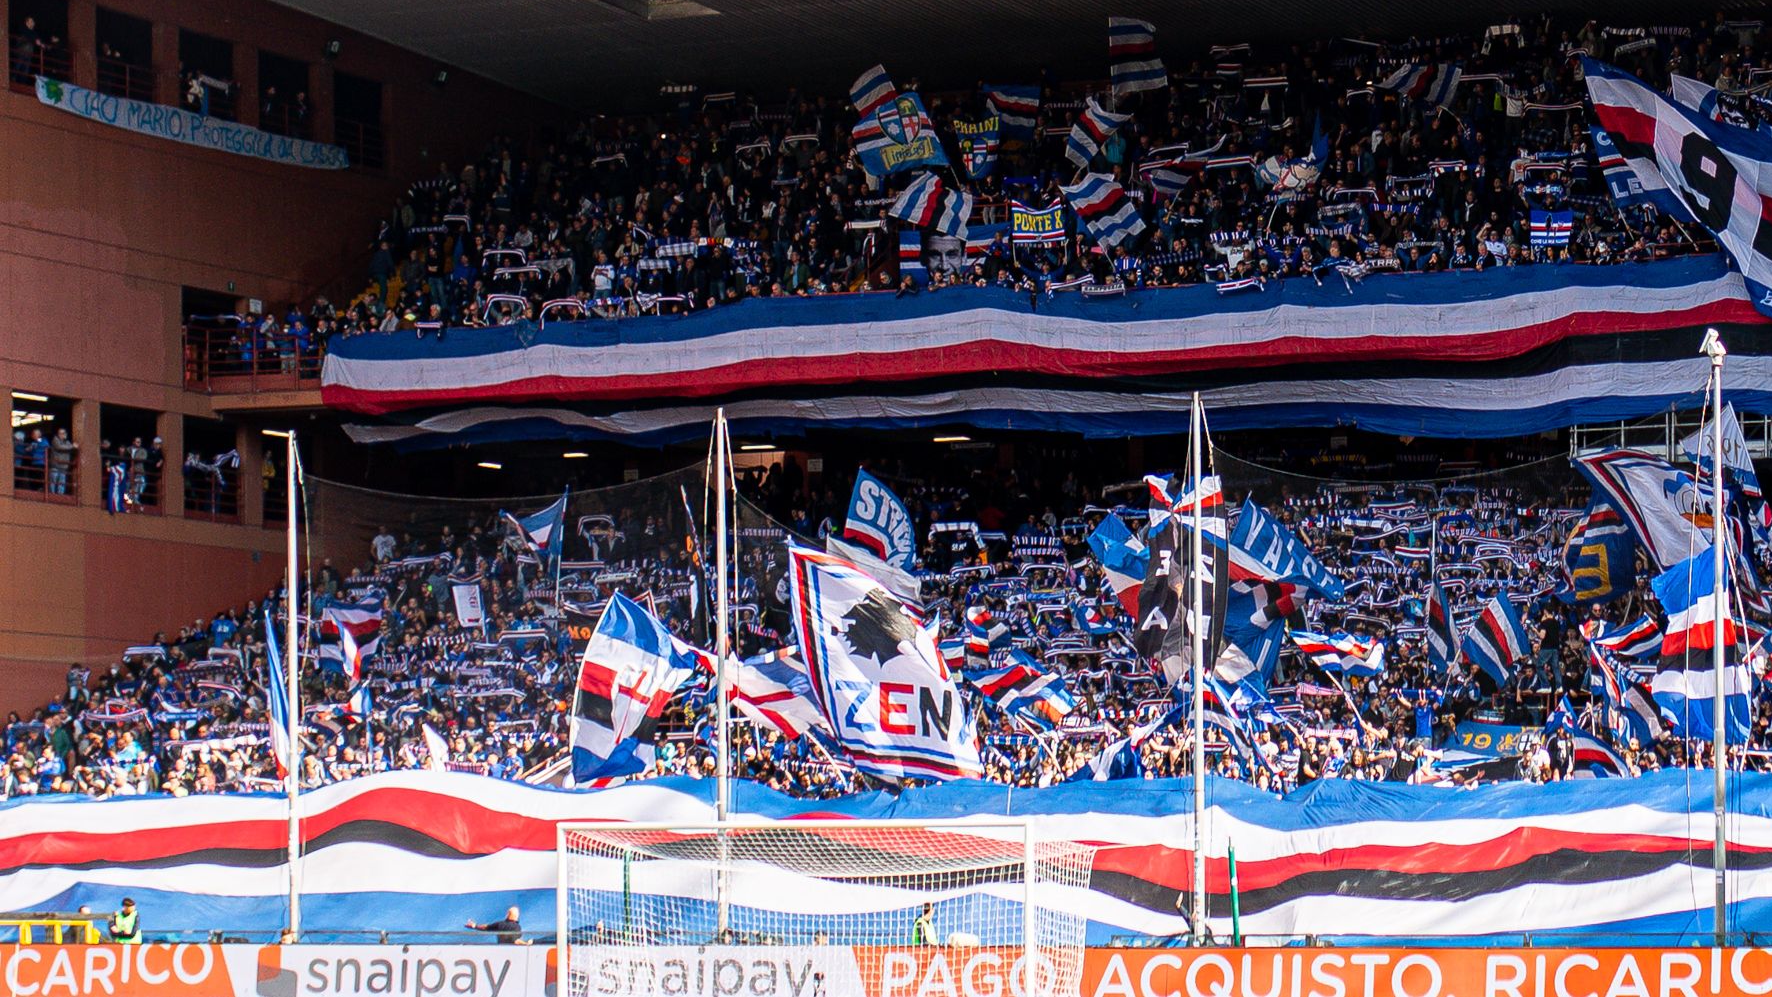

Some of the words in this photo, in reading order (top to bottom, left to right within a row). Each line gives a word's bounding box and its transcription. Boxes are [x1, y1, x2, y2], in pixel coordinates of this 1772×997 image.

[69, 87, 118, 124] CIAO
[1679, 132, 1738, 233] 9
[1013, 212, 1053, 231] PONTE
[836, 680, 958, 742] ZEN
[2, 944, 214, 996] CARICO
[306, 946, 511, 997] snaipay
[597, 946, 814, 997] snaipay
